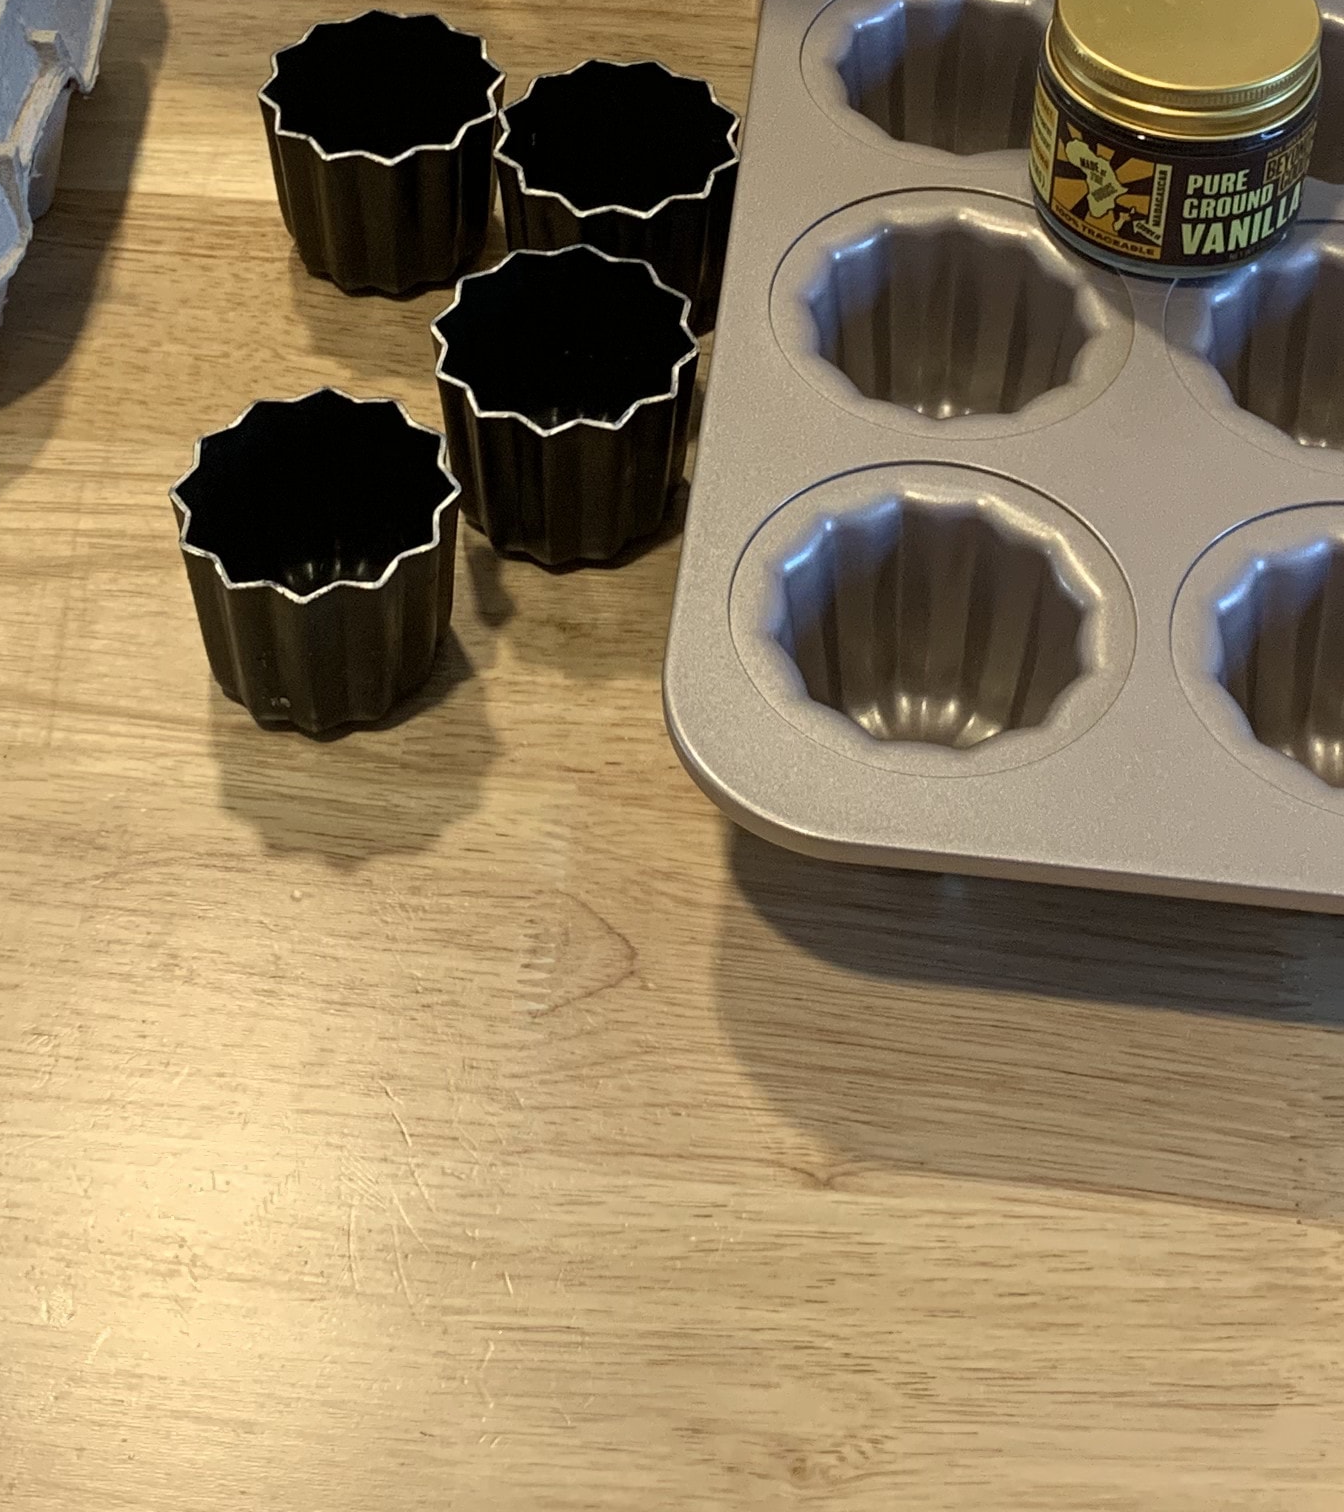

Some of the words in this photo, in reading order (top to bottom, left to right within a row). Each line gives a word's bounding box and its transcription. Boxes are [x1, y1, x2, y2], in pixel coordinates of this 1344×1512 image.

[1186, 168, 1251, 196] PURE
[1181, 180, 1302, 256] VANILLA
[1182, 183, 1274, 219] GROUND
[1081, 224, 1156, 257] TRACEABLE
